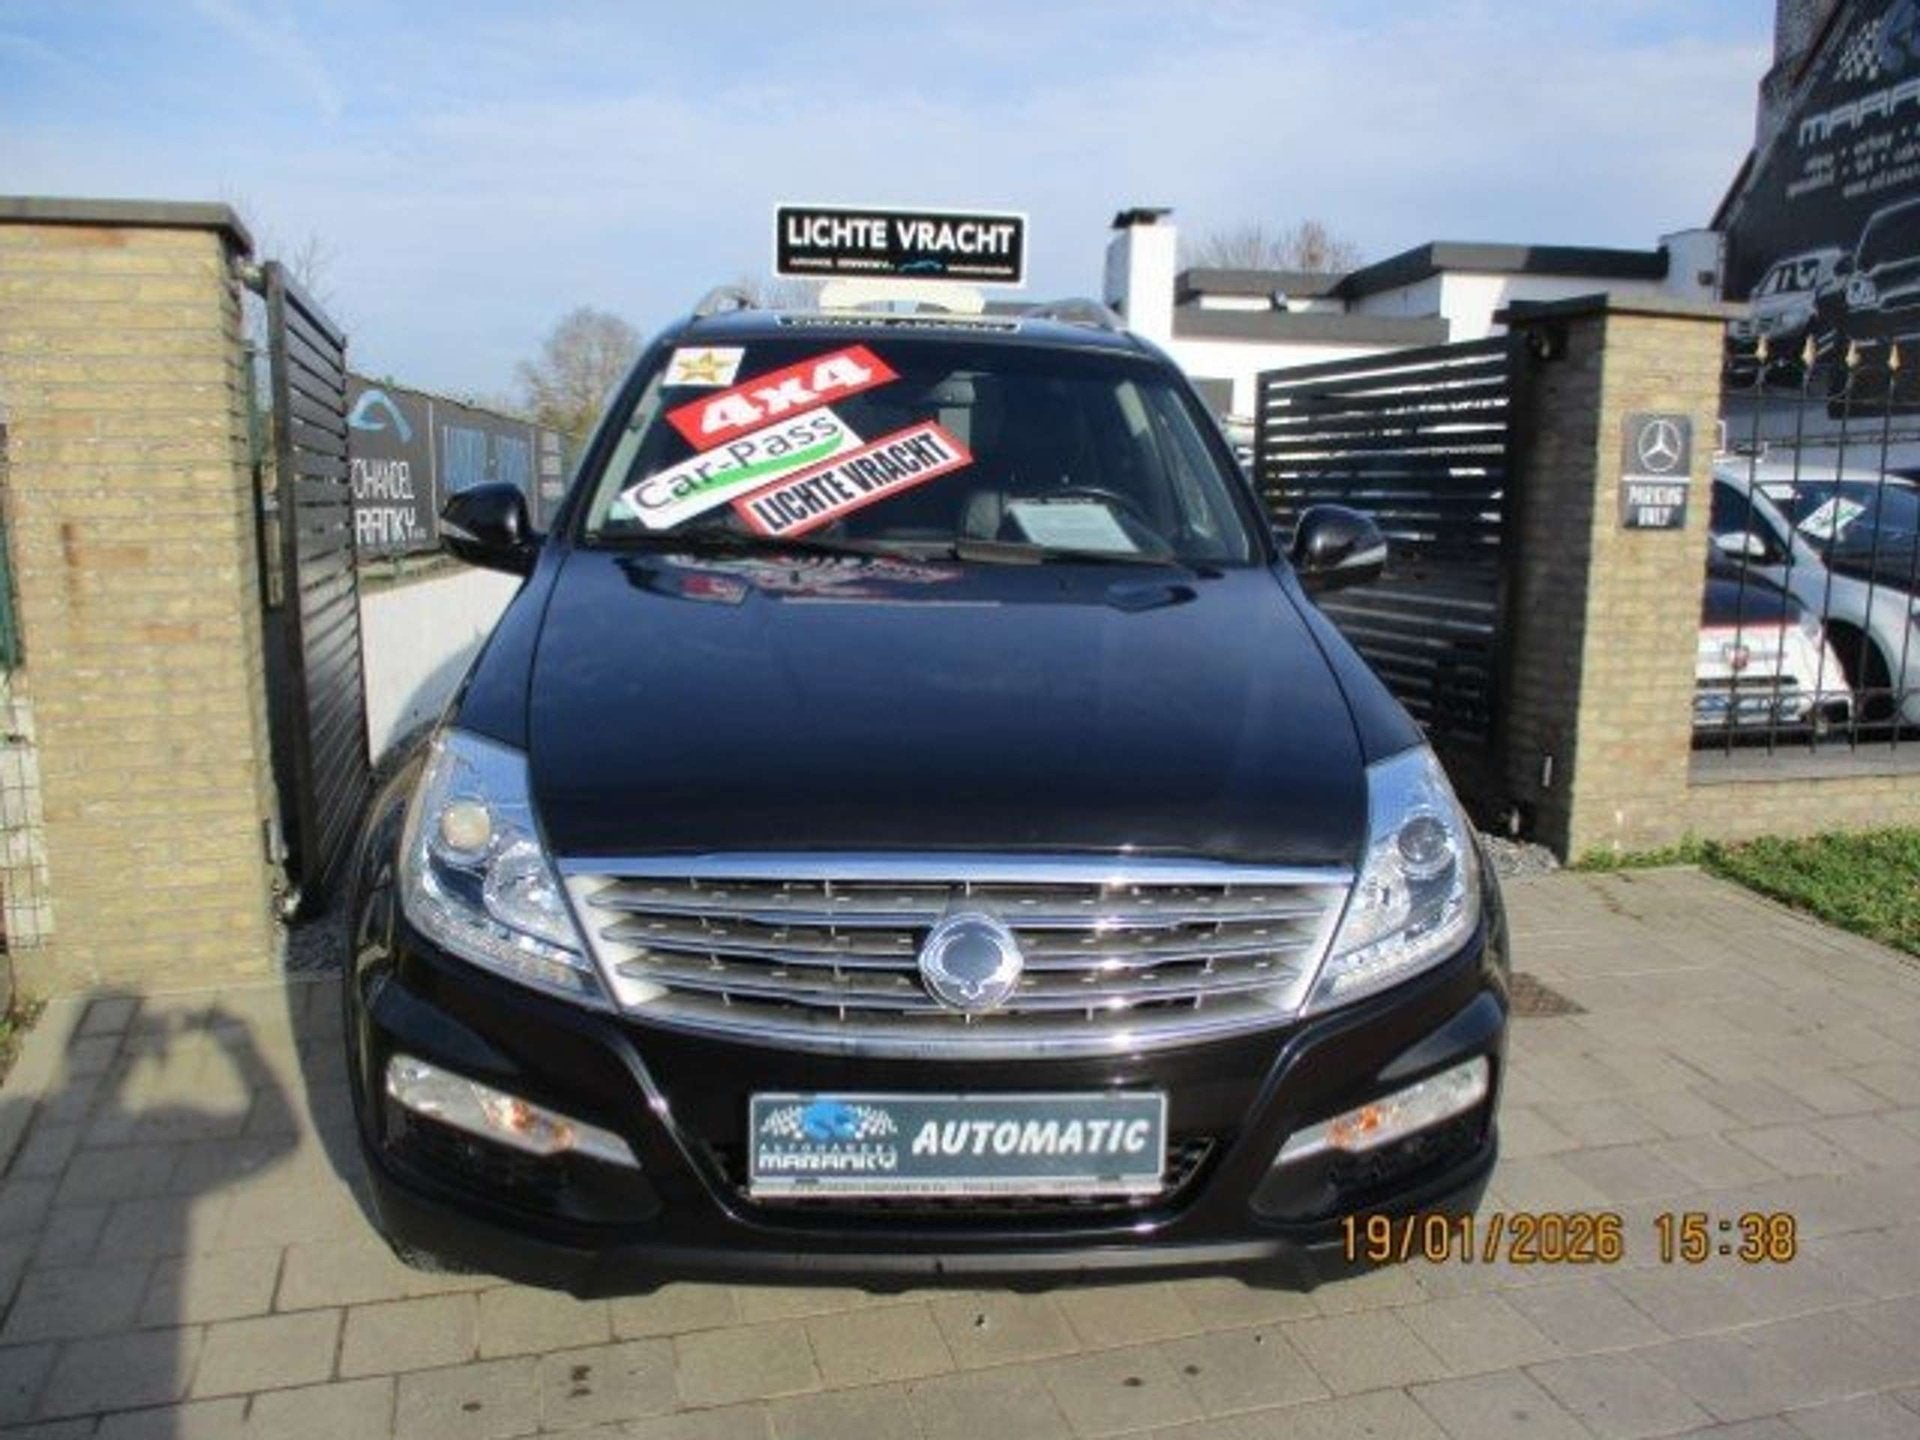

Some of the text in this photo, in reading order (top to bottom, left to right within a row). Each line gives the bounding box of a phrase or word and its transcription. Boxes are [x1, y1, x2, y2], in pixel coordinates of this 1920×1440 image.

[787, 216, 1016, 254] LICHTE VRACHT
[700, 355, 872, 434] 4x4
[633, 414, 839, 510] Car-Pass
[752, 431, 950, 532] LICHTE VRACHT
[911, 1119, 1151, 1157] AUTOMATIC
